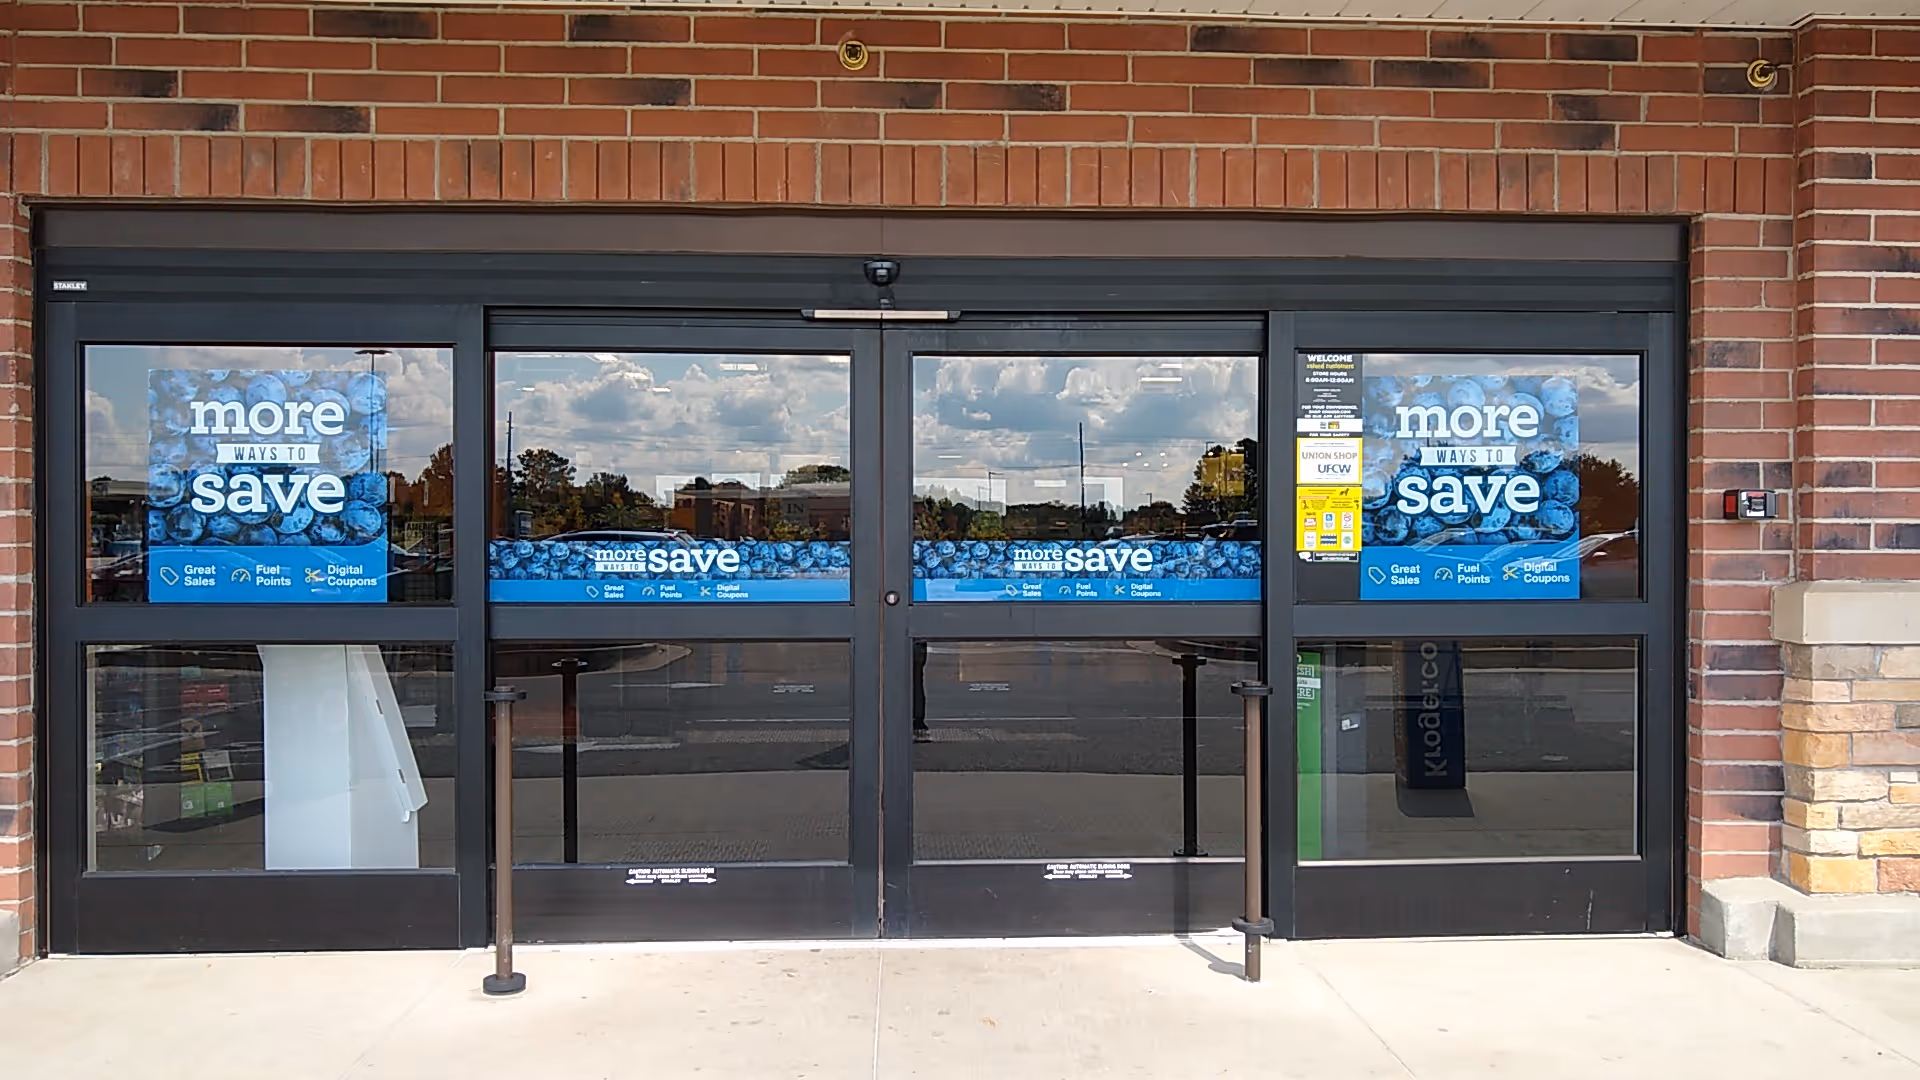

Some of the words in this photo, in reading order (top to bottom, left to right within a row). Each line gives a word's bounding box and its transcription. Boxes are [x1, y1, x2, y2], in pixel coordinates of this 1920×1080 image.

[1307, 354, 1353, 363] WELCOME
[190, 400, 345, 436] more
[1395, 403, 1539, 439] more
[234, 446, 278, 461] WAYS
[288, 446, 306, 461] TO
[1302, 452, 1332, 460] UNION
[1334, 452, 1358, 460] SHOP
[1436, 449, 1477, 463] WAYS
[1486, 449, 1503, 463] TO
[1317, 464, 1352, 473] UFCW
[191, 473, 346, 513] save
[1396, 475, 1541, 514] save
[595, 549, 647, 561] more
[648, 548, 740, 573] save
[1013, 549, 1063, 561] more
[1065, 548, 1154, 572] save
[184, 564, 216, 575] Great
[256, 564, 280, 575] Fuel
[327, 564, 363, 577] Digital
[603, 563, 625, 571] WAYS
[628, 563, 640, 571] TO
[1021, 562, 1043, 570] WAYS
[1046, 562, 1056, 570] TO
[1391, 564, 1421, 575] Great
[1457, 563, 1480, 573] Fuel
[1524, 562, 1557, 574] Digital
[184, 576, 216, 587] Sales
[256, 576, 292, 587] Points
[327, 576, 378, 588] Coupons
[1391, 575, 1420, 585] Sales
[1457, 574, 1491, 584] Points
[1524, 573, 1570, 585] Coupons
[604, 584, 625, 592] Great
[660, 584, 676, 592] Fuel
[717, 584, 740, 593] Digital
[1131, 583, 1154, 591] Digital
[1131, 590, 1162, 598] Coupons
